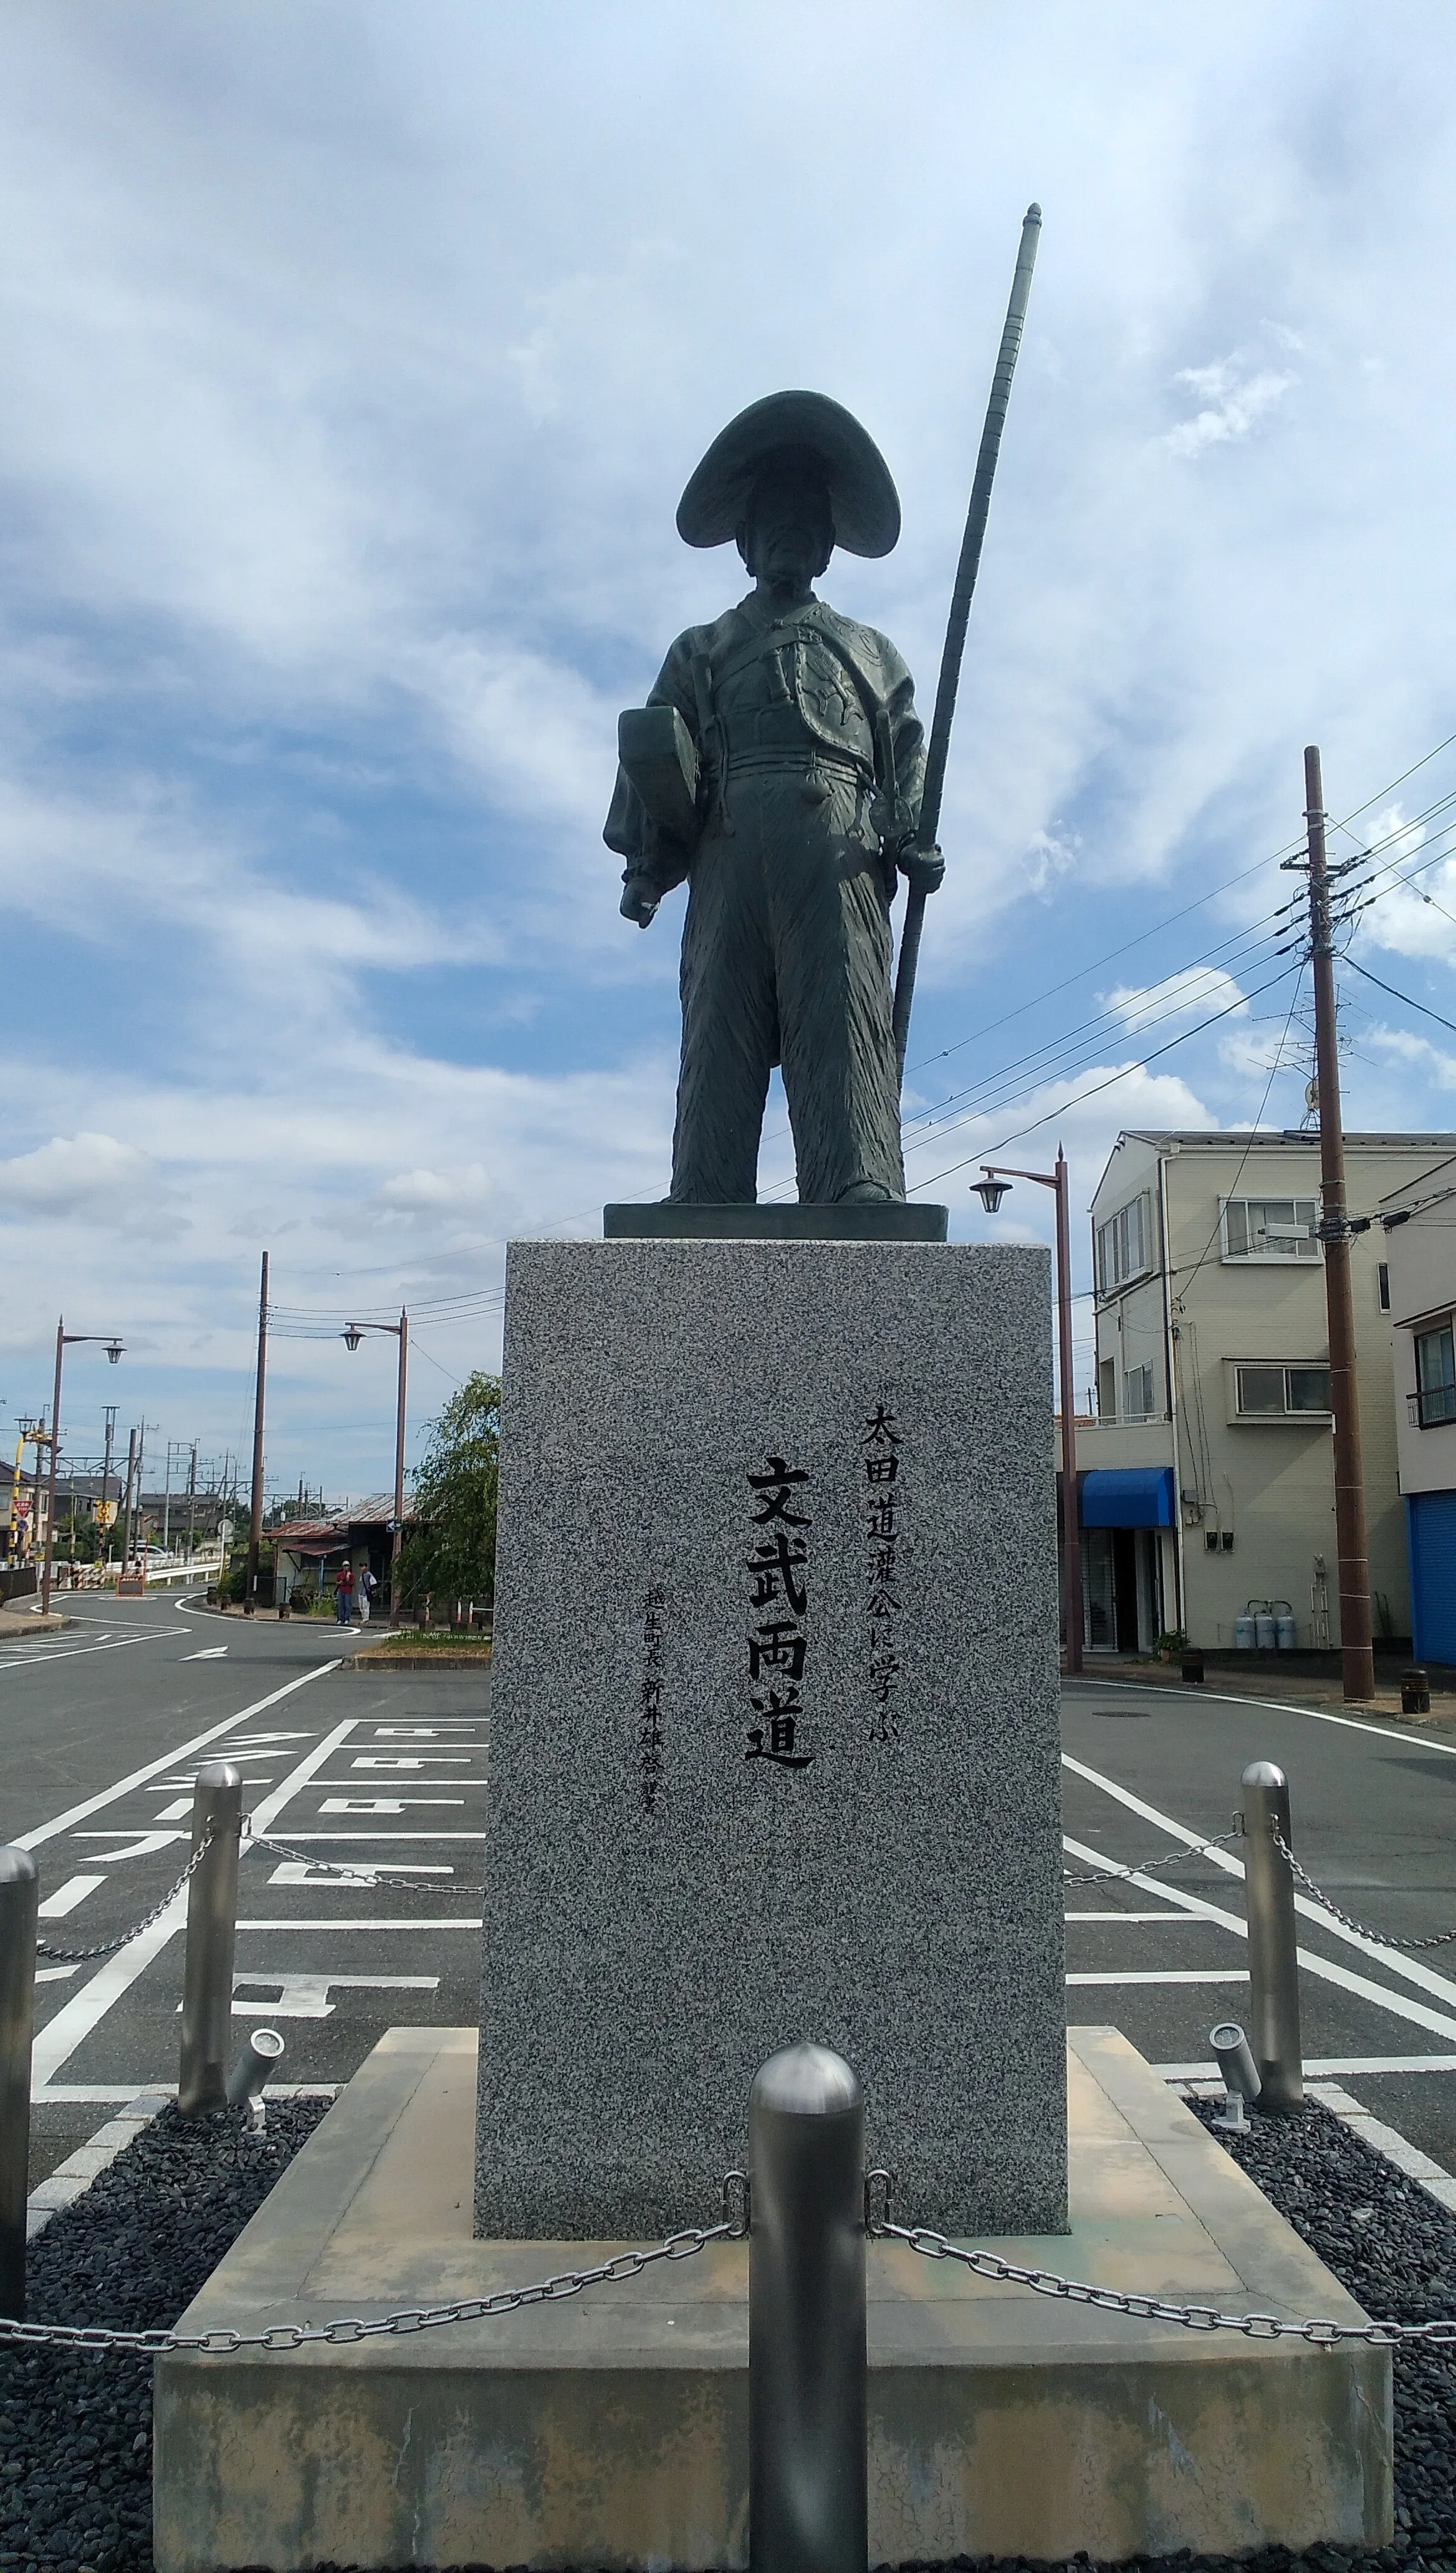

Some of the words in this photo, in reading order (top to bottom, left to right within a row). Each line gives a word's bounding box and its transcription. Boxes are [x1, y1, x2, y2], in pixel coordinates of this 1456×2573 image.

[745, 1457, 814, 1768] 文武両道
[861, 1405, 904, 1742] 太田道灌公に学ぶ
